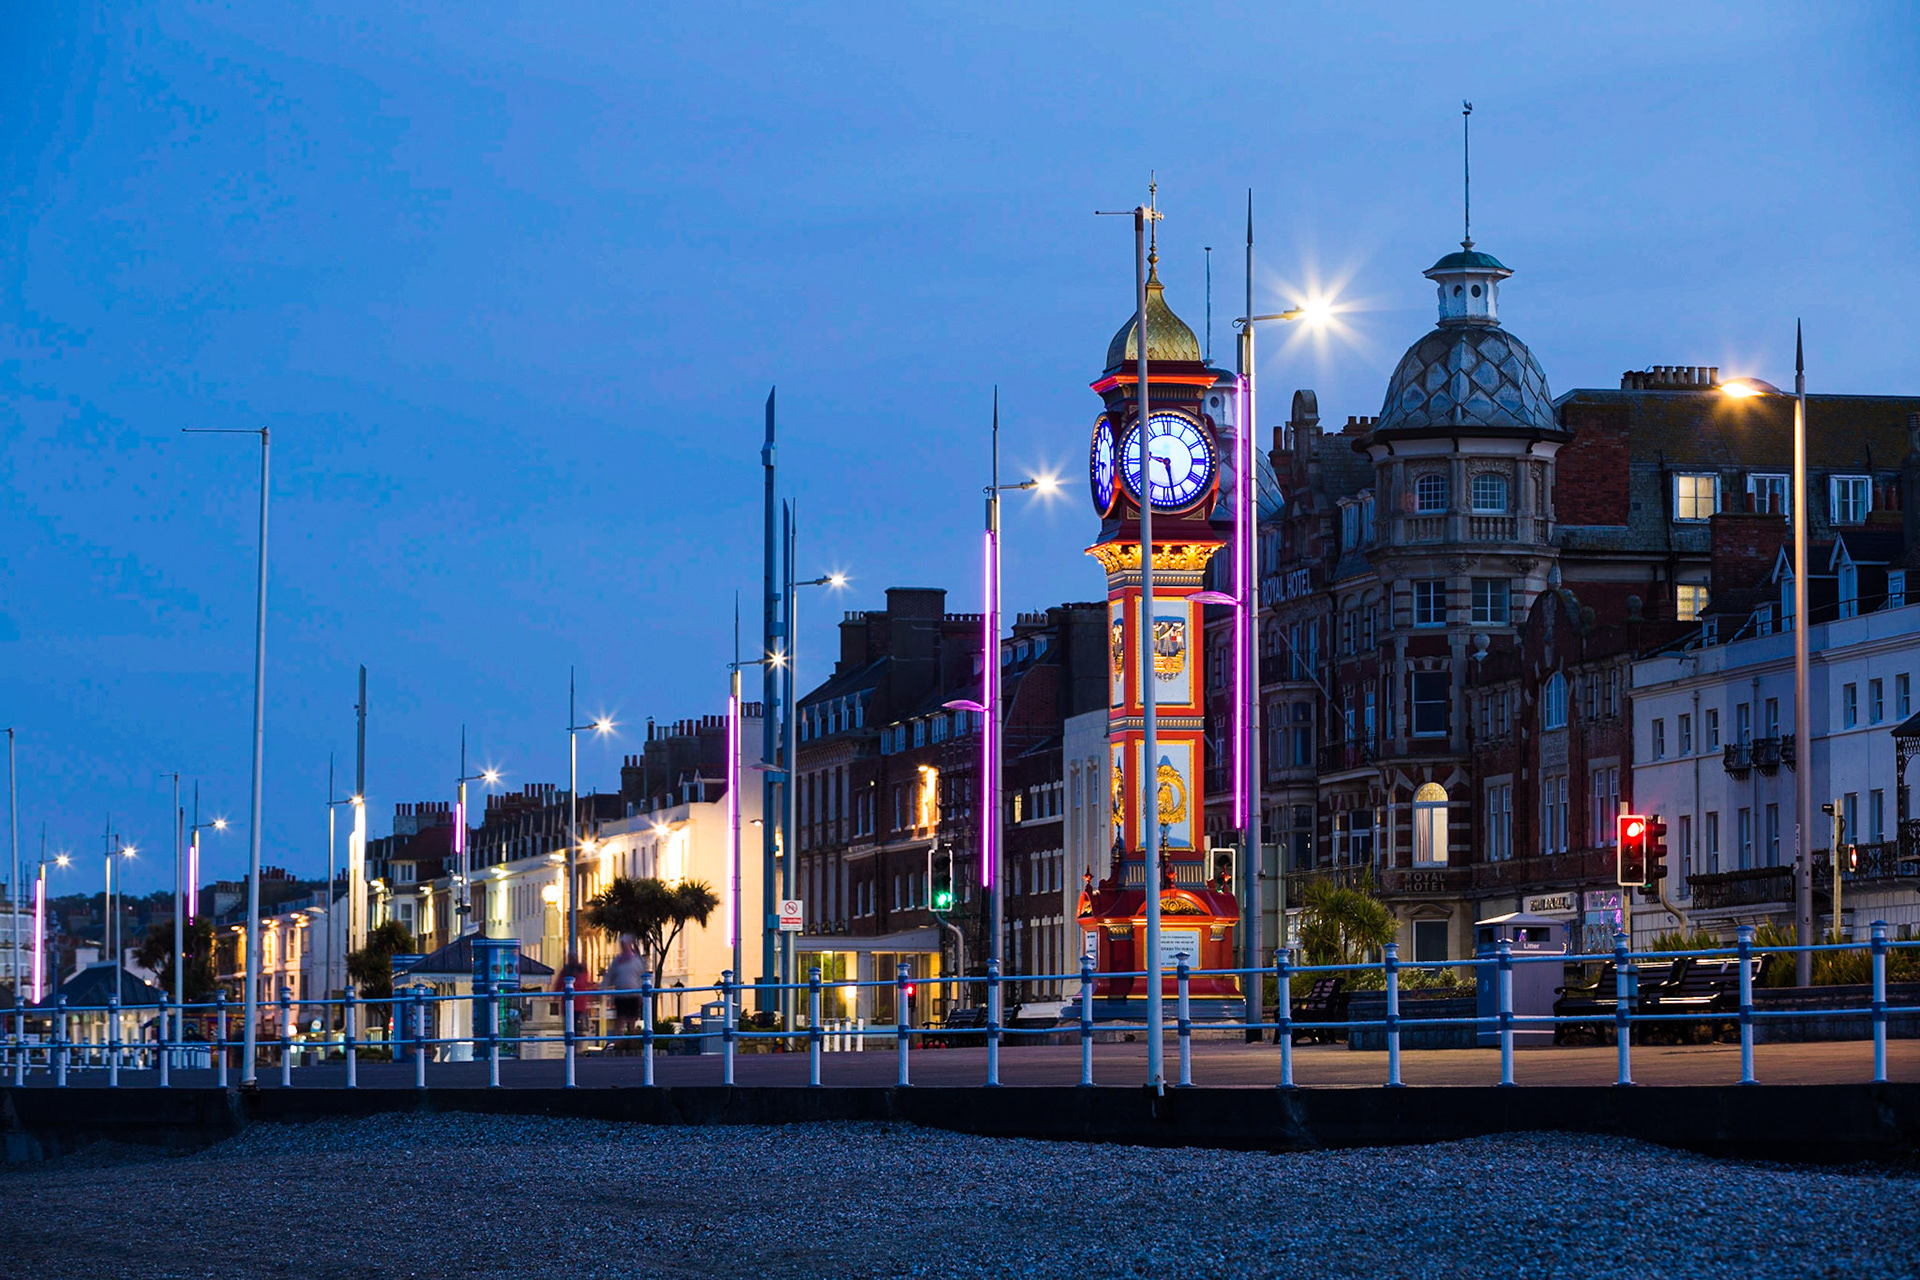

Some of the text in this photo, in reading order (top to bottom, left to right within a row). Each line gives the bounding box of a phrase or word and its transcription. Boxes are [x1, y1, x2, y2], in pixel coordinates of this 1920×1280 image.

[1262, 567, 1313, 607] ROYAL HOTEL
[1405, 872, 1446, 882] ROYAL
[1404, 882, 1447, 892] HOTEL
[1523, 942, 1541, 950] Litter
